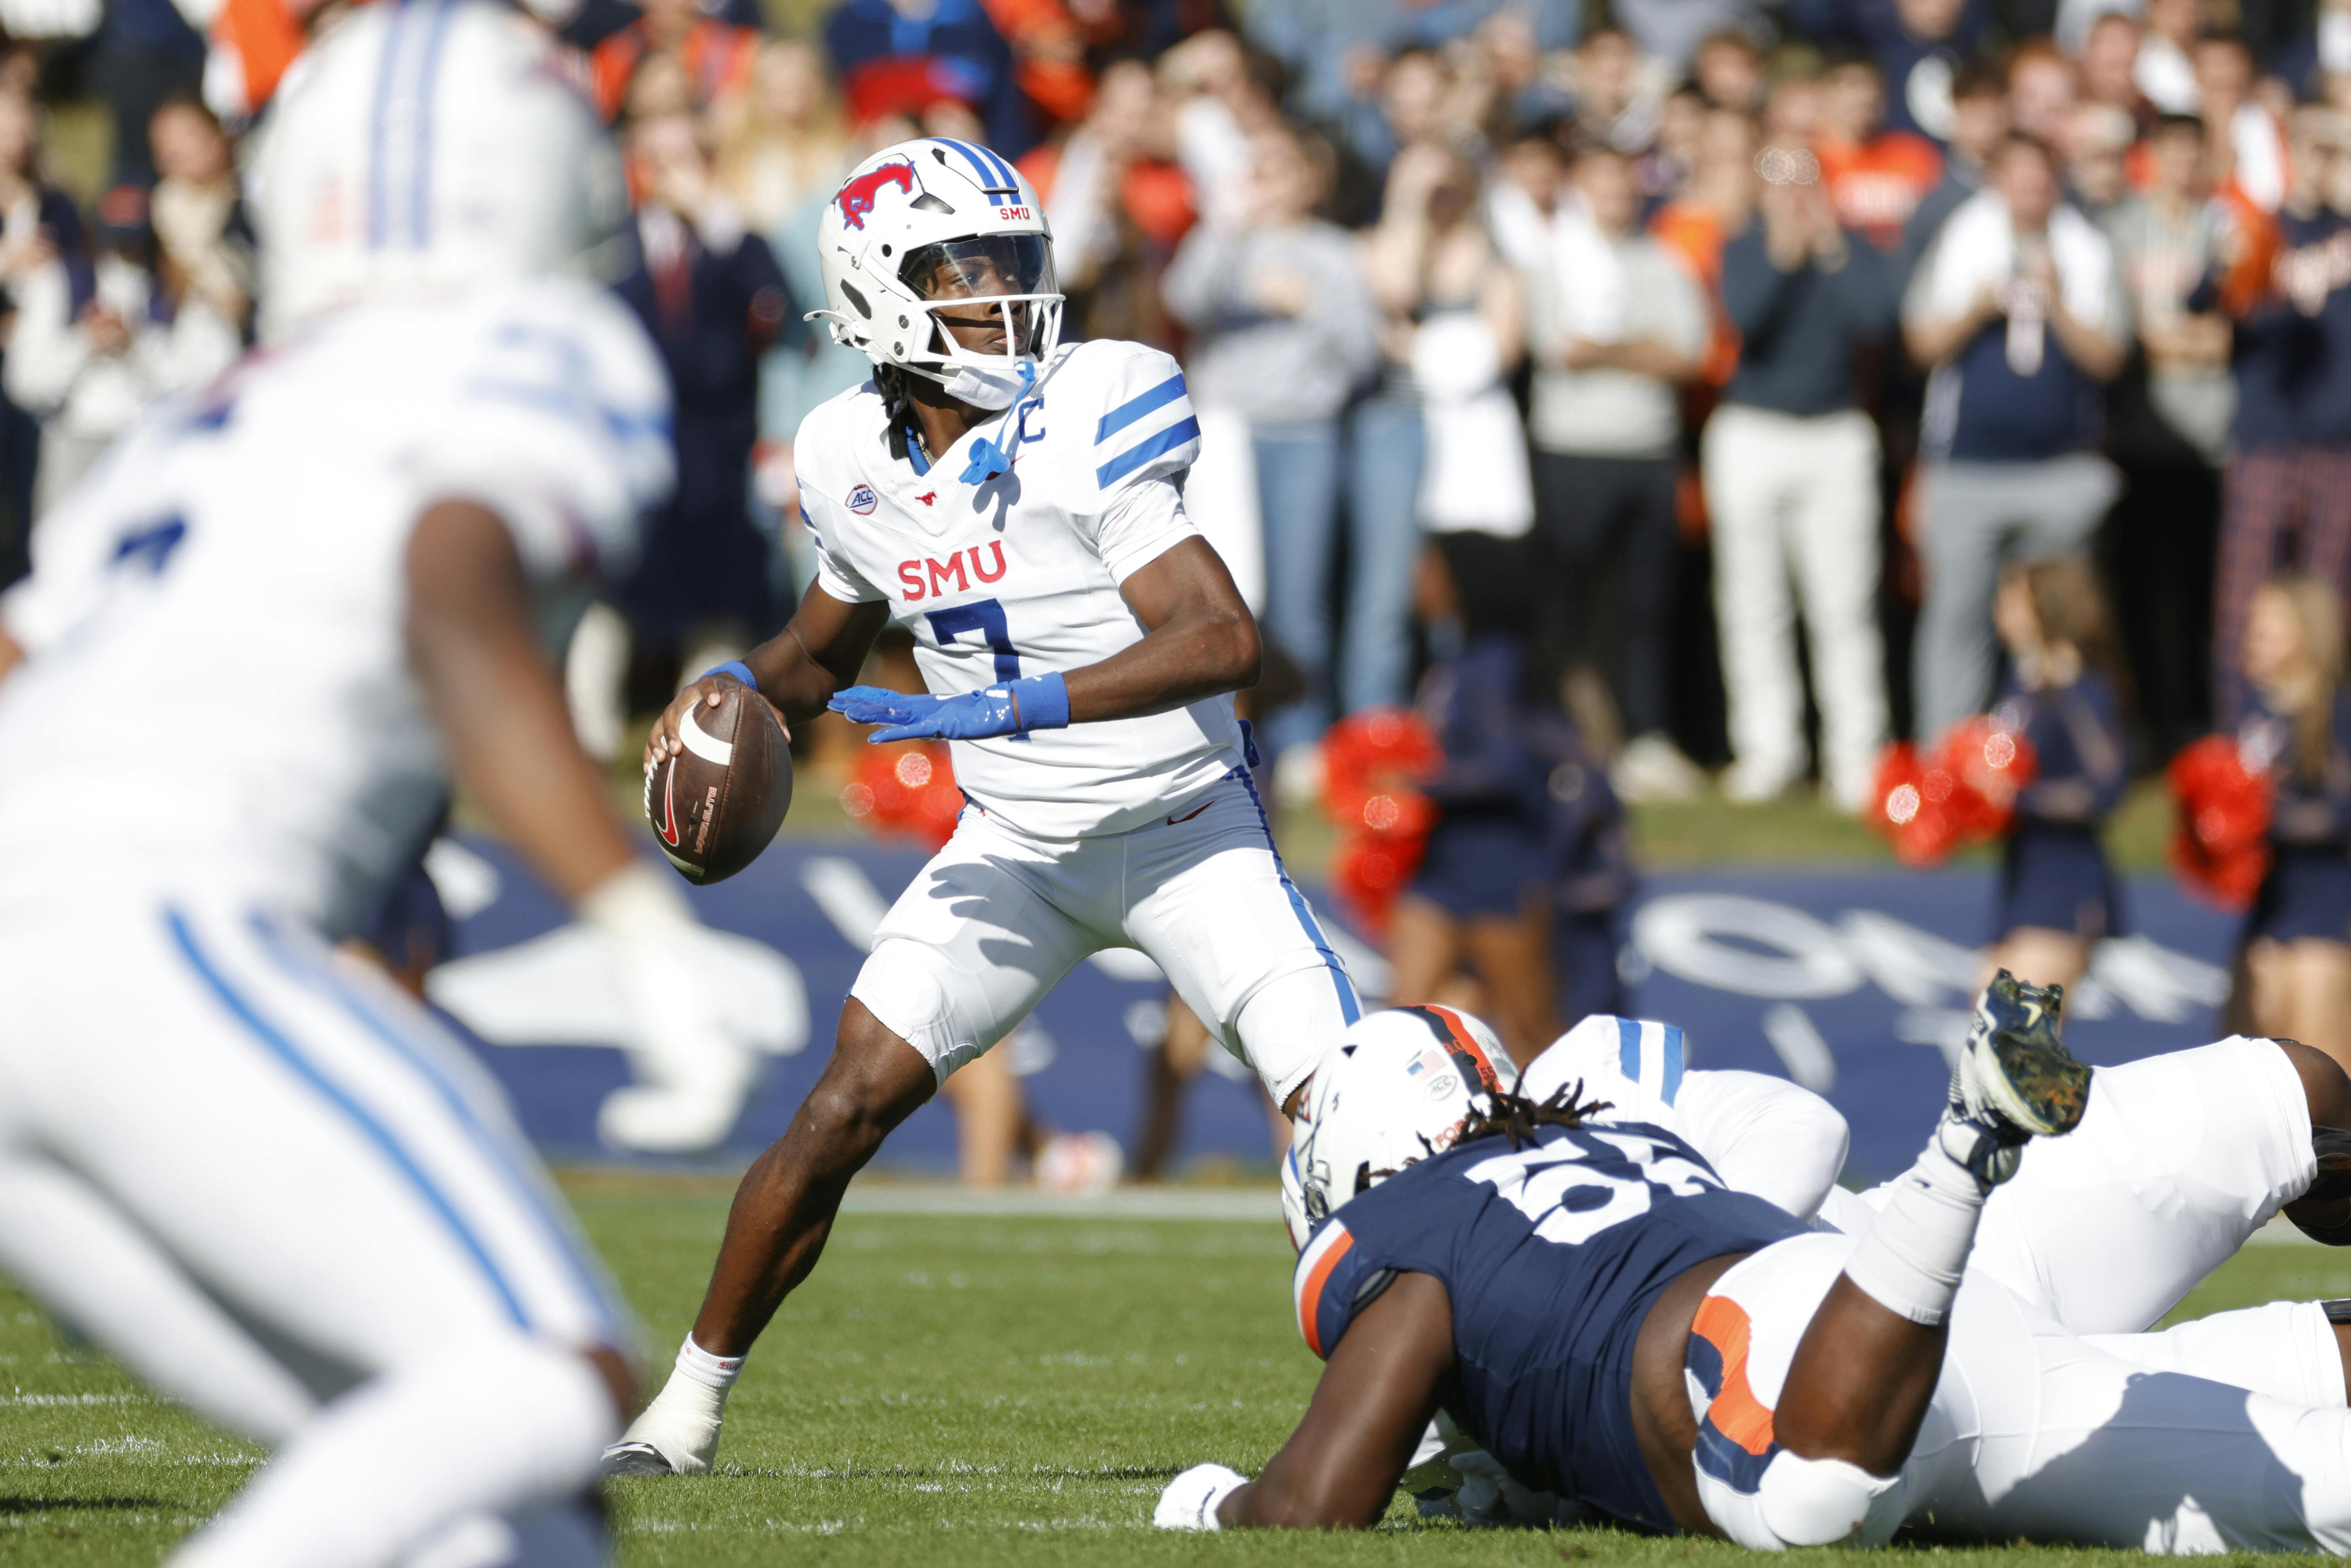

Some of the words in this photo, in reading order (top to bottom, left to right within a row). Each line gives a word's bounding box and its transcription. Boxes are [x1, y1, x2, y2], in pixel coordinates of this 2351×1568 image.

[1000, 207, 1030, 220] SMU
[1018, 397, 1046, 444] C
[851, 490, 873, 505] ACC
[898, 540, 1006, 601] SMU
[923, 598, 1031, 742] 7
[694, 822, 710, 854] VAPOR
[702, 786, 718, 822] ELITE
[1430, 1076, 1452, 1095] ACC
